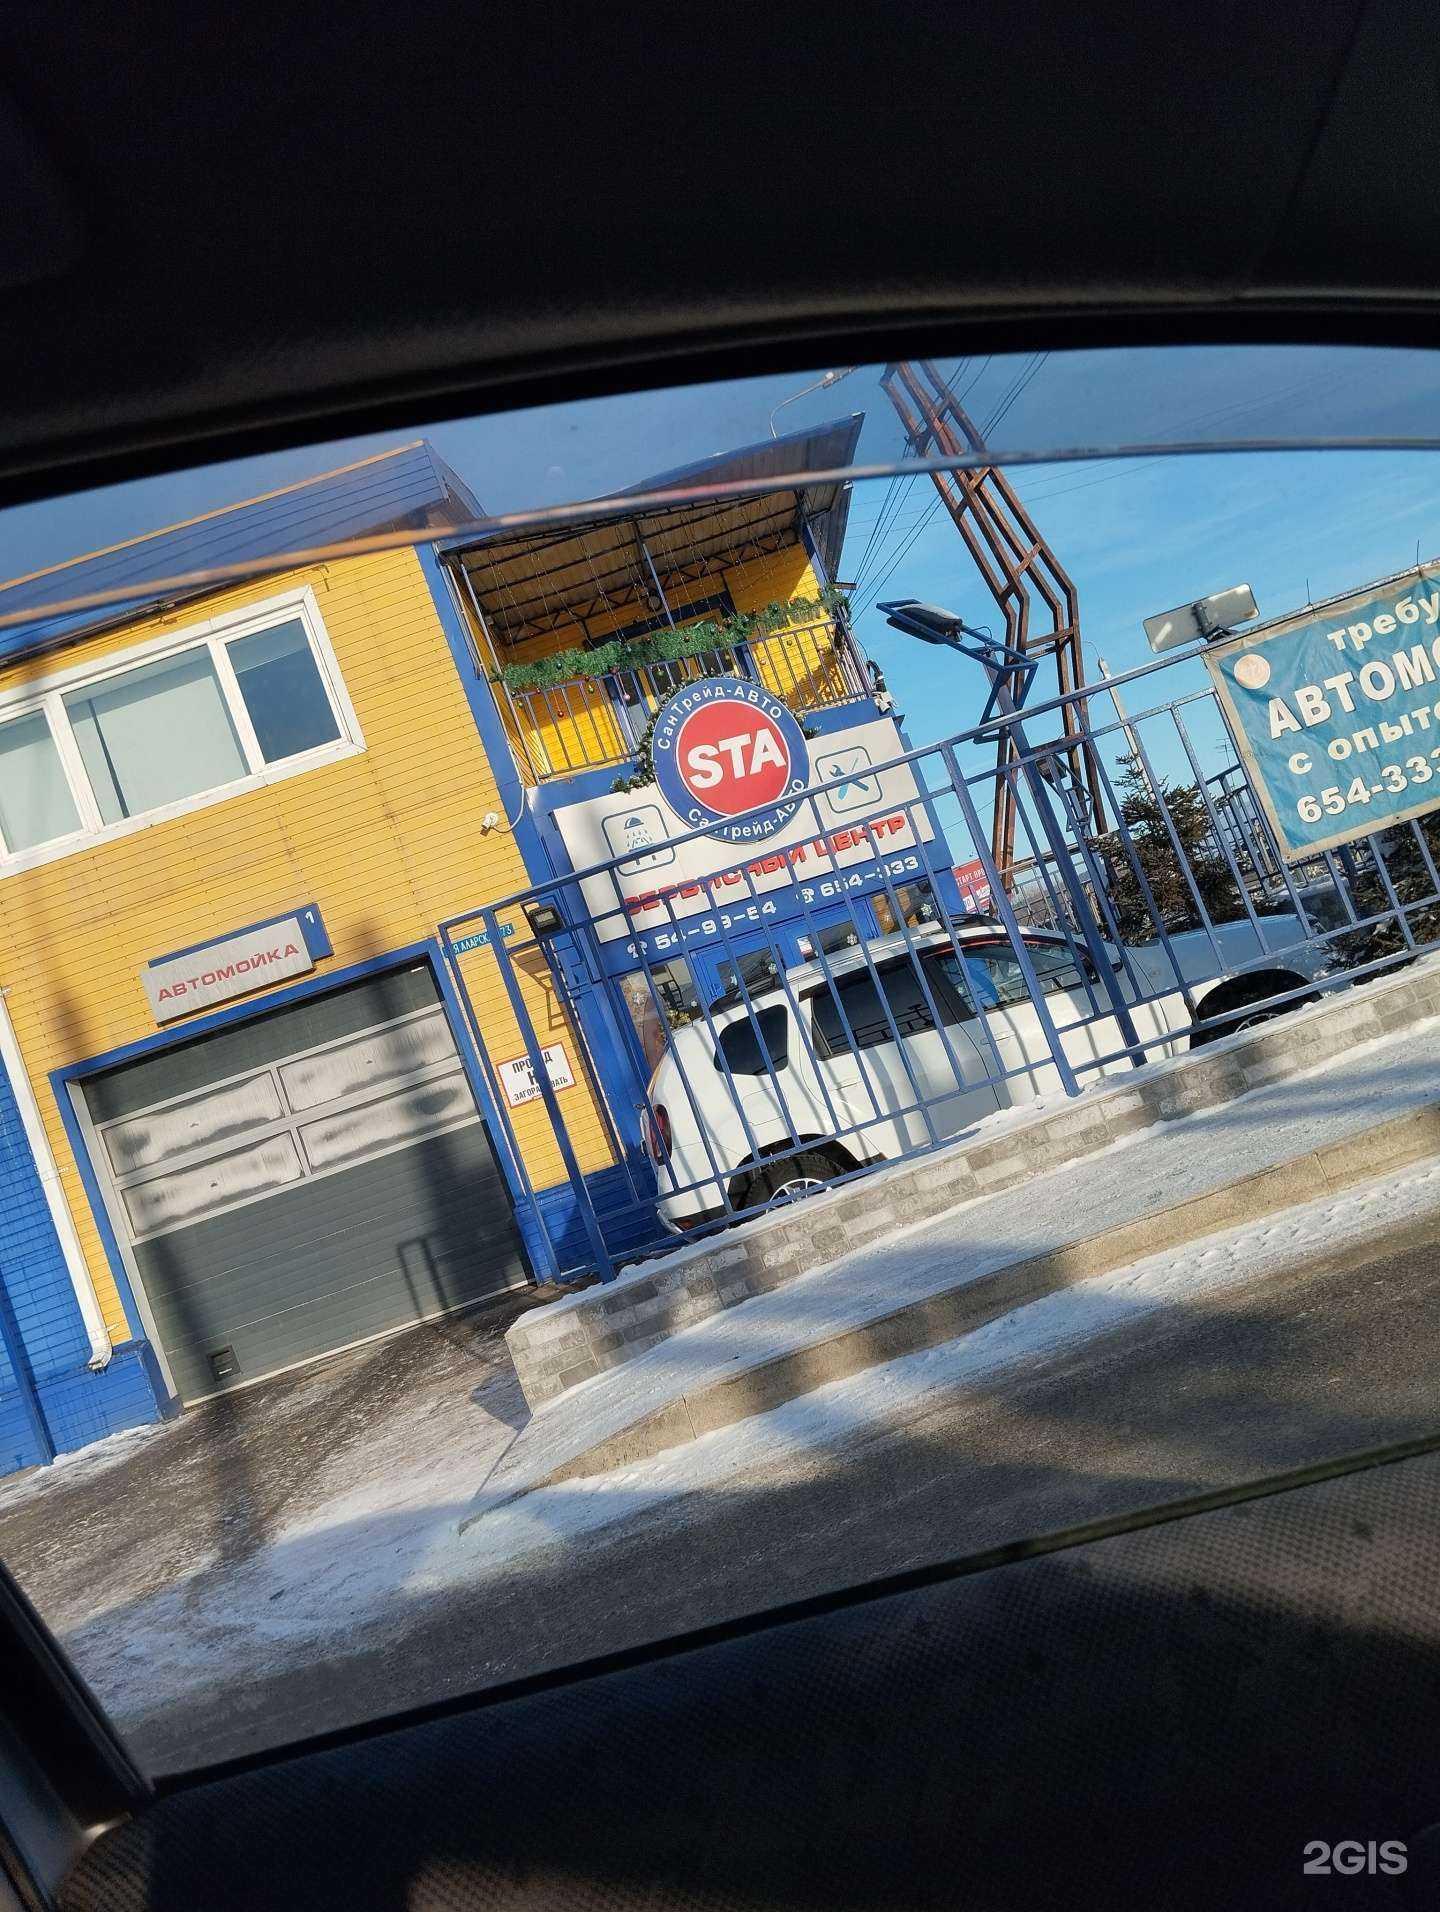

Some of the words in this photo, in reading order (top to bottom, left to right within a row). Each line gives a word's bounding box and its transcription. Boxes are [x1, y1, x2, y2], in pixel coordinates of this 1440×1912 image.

[687, 728, 786, 789] STA
[158, 943, 299, 1002] АВТОМОЙКА
[512, 1051, 553, 1074] ПРОД
[513, 1076, 568, 1101] ЗАГОРАВАТЬ
